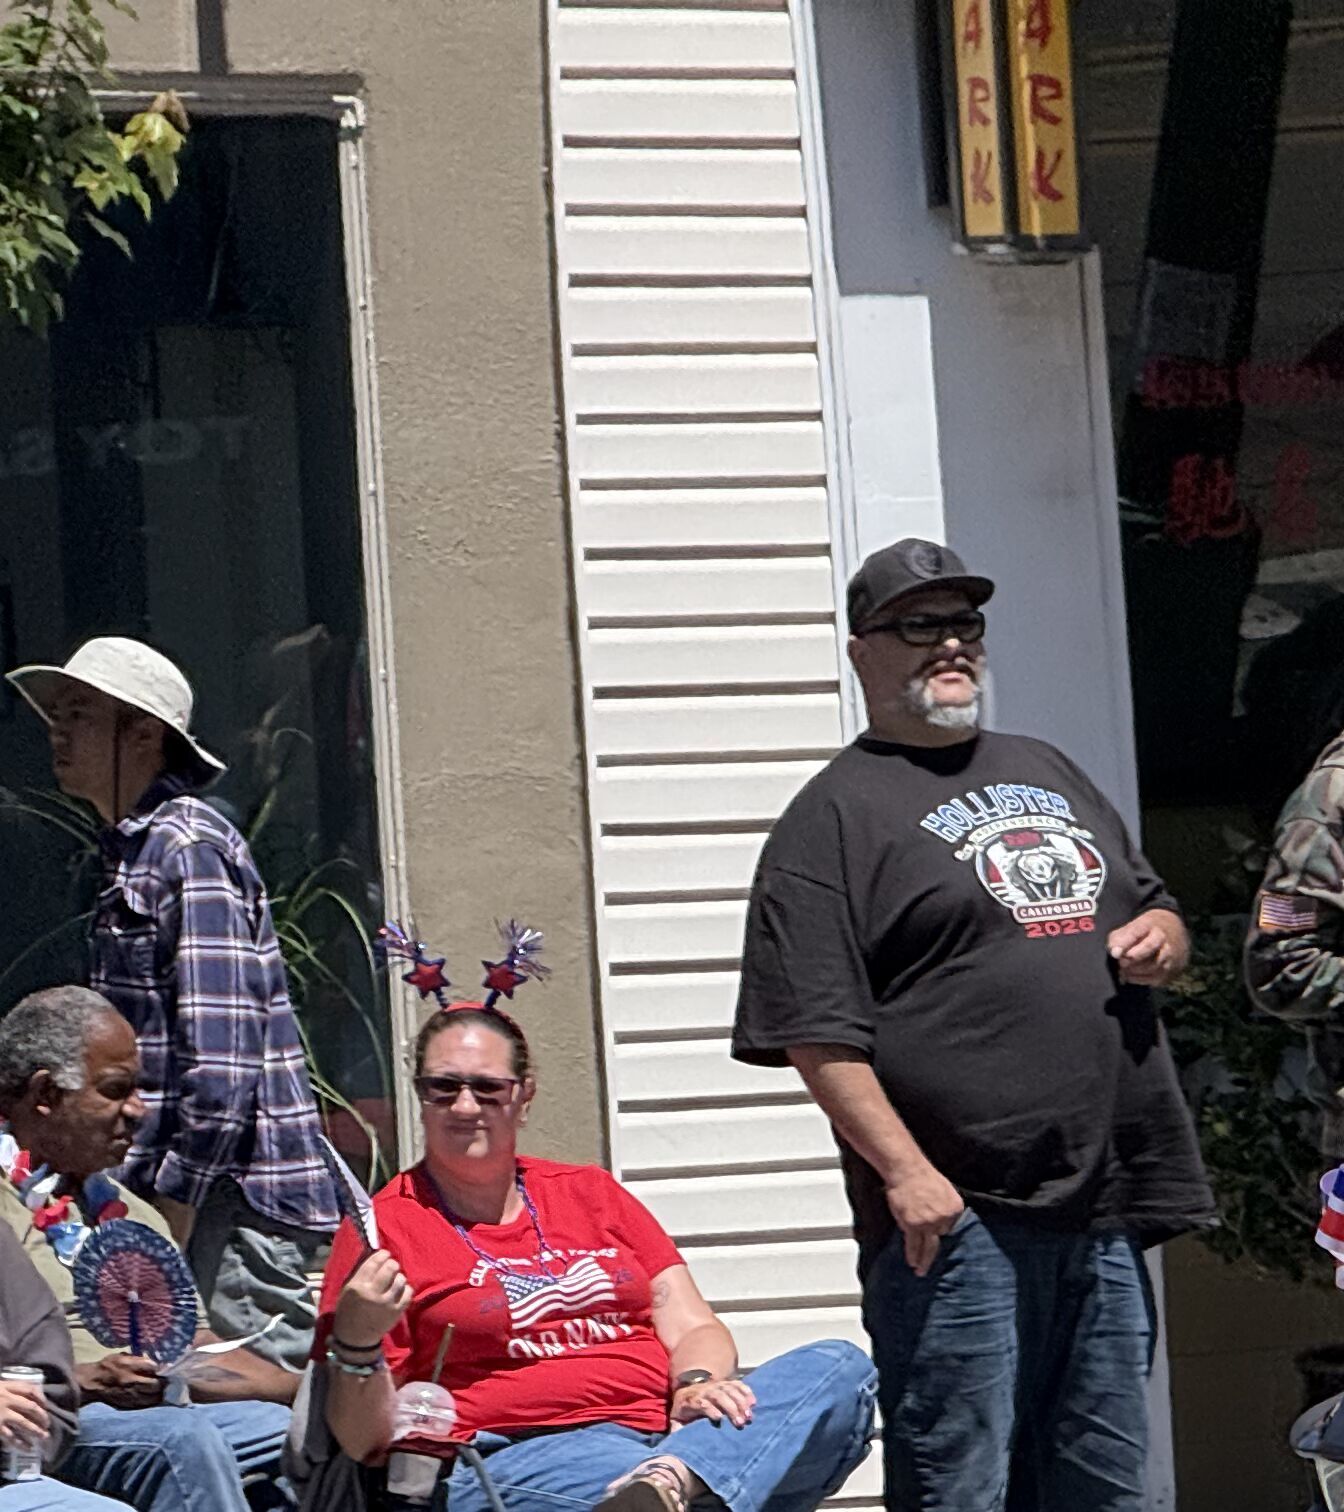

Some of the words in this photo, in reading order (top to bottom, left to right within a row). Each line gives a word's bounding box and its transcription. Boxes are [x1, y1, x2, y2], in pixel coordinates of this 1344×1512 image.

[919, 783, 1076, 844] HOLLISTER
[971, 816, 1063, 842] INDEPENDENCE
[1019, 900, 1092, 918] CALIFORNIA
[1024, 917, 1096, 938] 2026
